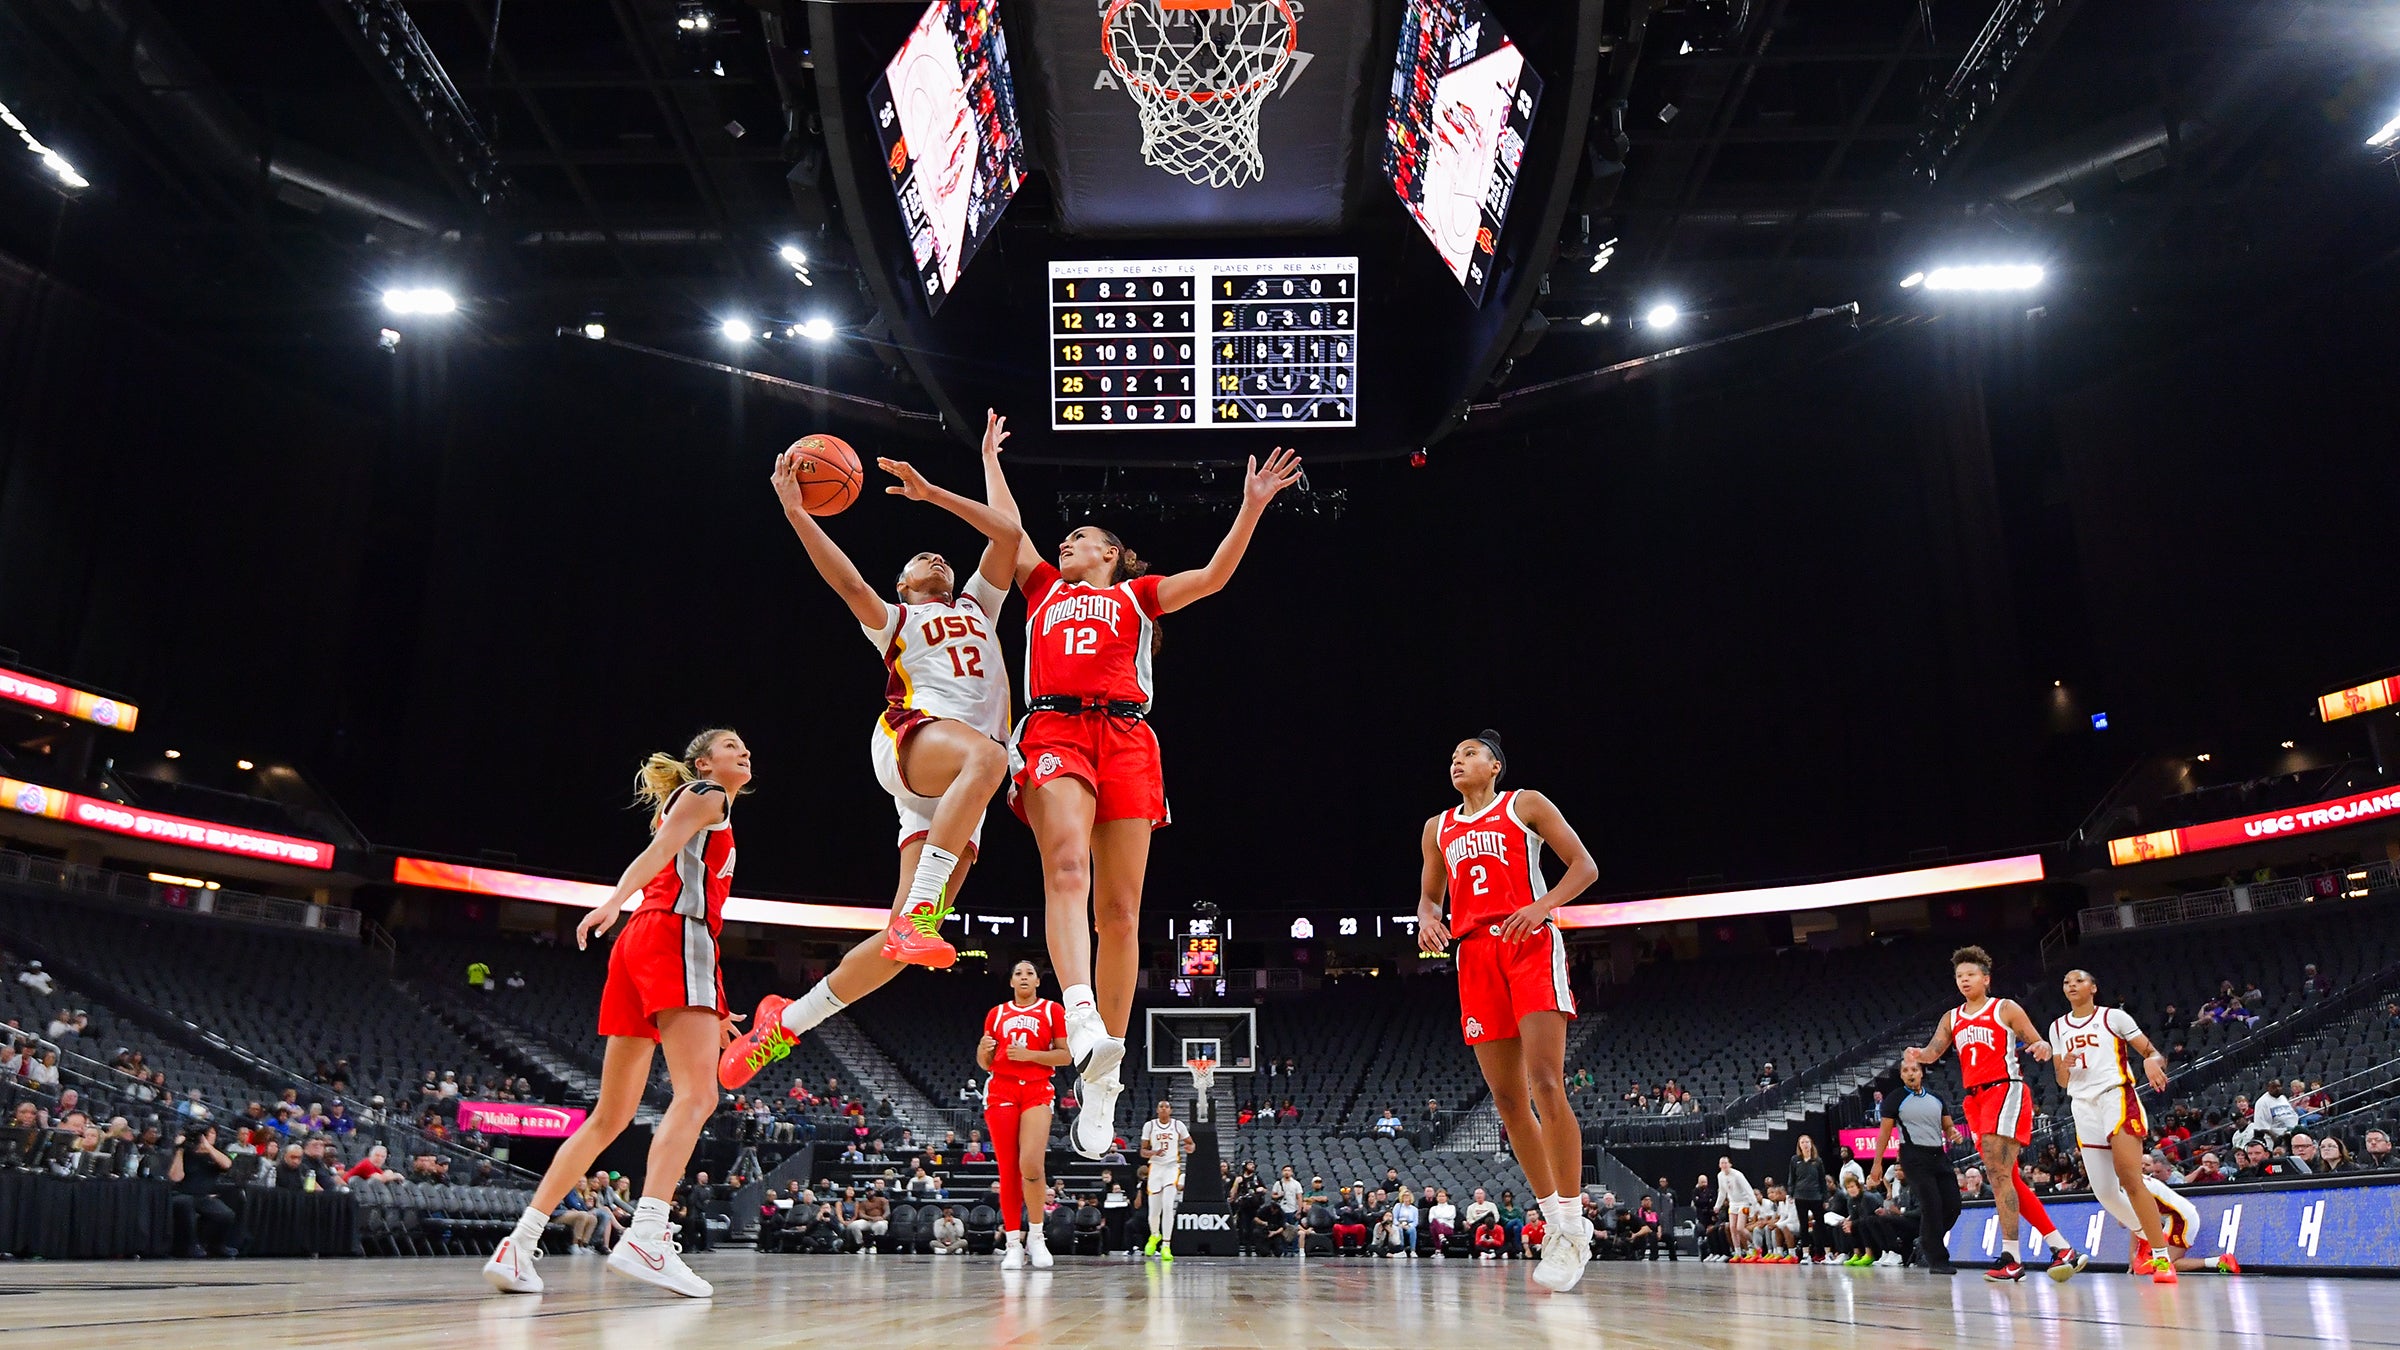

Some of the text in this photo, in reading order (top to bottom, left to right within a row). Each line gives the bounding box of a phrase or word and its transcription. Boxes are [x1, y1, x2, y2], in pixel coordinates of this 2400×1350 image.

[1054, 265, 1195, 275] PLAYER PTS REB AST FLS
[1213, 263, 1353, 273] PLAYER PTS REB AST FLS
[1066, 281, 1189, 299] 1 8 2 0 1
[1223, 278, 1347, 296] 1 3 0 0 1
[1061, 311, 1189, 329] 12 12 3 2 1
[1222, 309, 1348, 327] 2 0 3 0 2
[1062, 343, 1191, 361] 13 10 8 0 0
[1222, 341, 1348, 359] 4 8 2 1 0
[1062, 375, 1189, 393] 25 0 2 1 1
[1218, 373, 1348, 391] 12 5 1 2 0
[1062, 404, 1191, 421] 45 3 0 2 0
[1218, 402, 1346, 419] 14 0 0 1 1
[921, 615, 987, 647] USC
[1063, 627, 1097, 655] 12
[947, 645, 985, 679] 12
[2244, 792, 2400, 837] USC TROJANS
[79, 803, 319, 862] OHIO STATE BUCKEYES
[1470, 864, 1489, 896] 2
[1339, 918, 1357, 935] 23
[1406, 923, 1414, 935] 2
[1189, 938, 1218, 952] 2:52
[1185, 951, 1216, 975] 25
[2065, 1034, 2100, 1053] USC
[1969, 1047, 1977, 1067] 1
[2079, 1052, 2088, 1069] 1
[485, 1111, 520, 1126] Mobile
[521, 1116, 561, 1128] ARENA
[1156, 1132, 1174, 1141] USC
[1177, 1213, 1230, 1231] max
